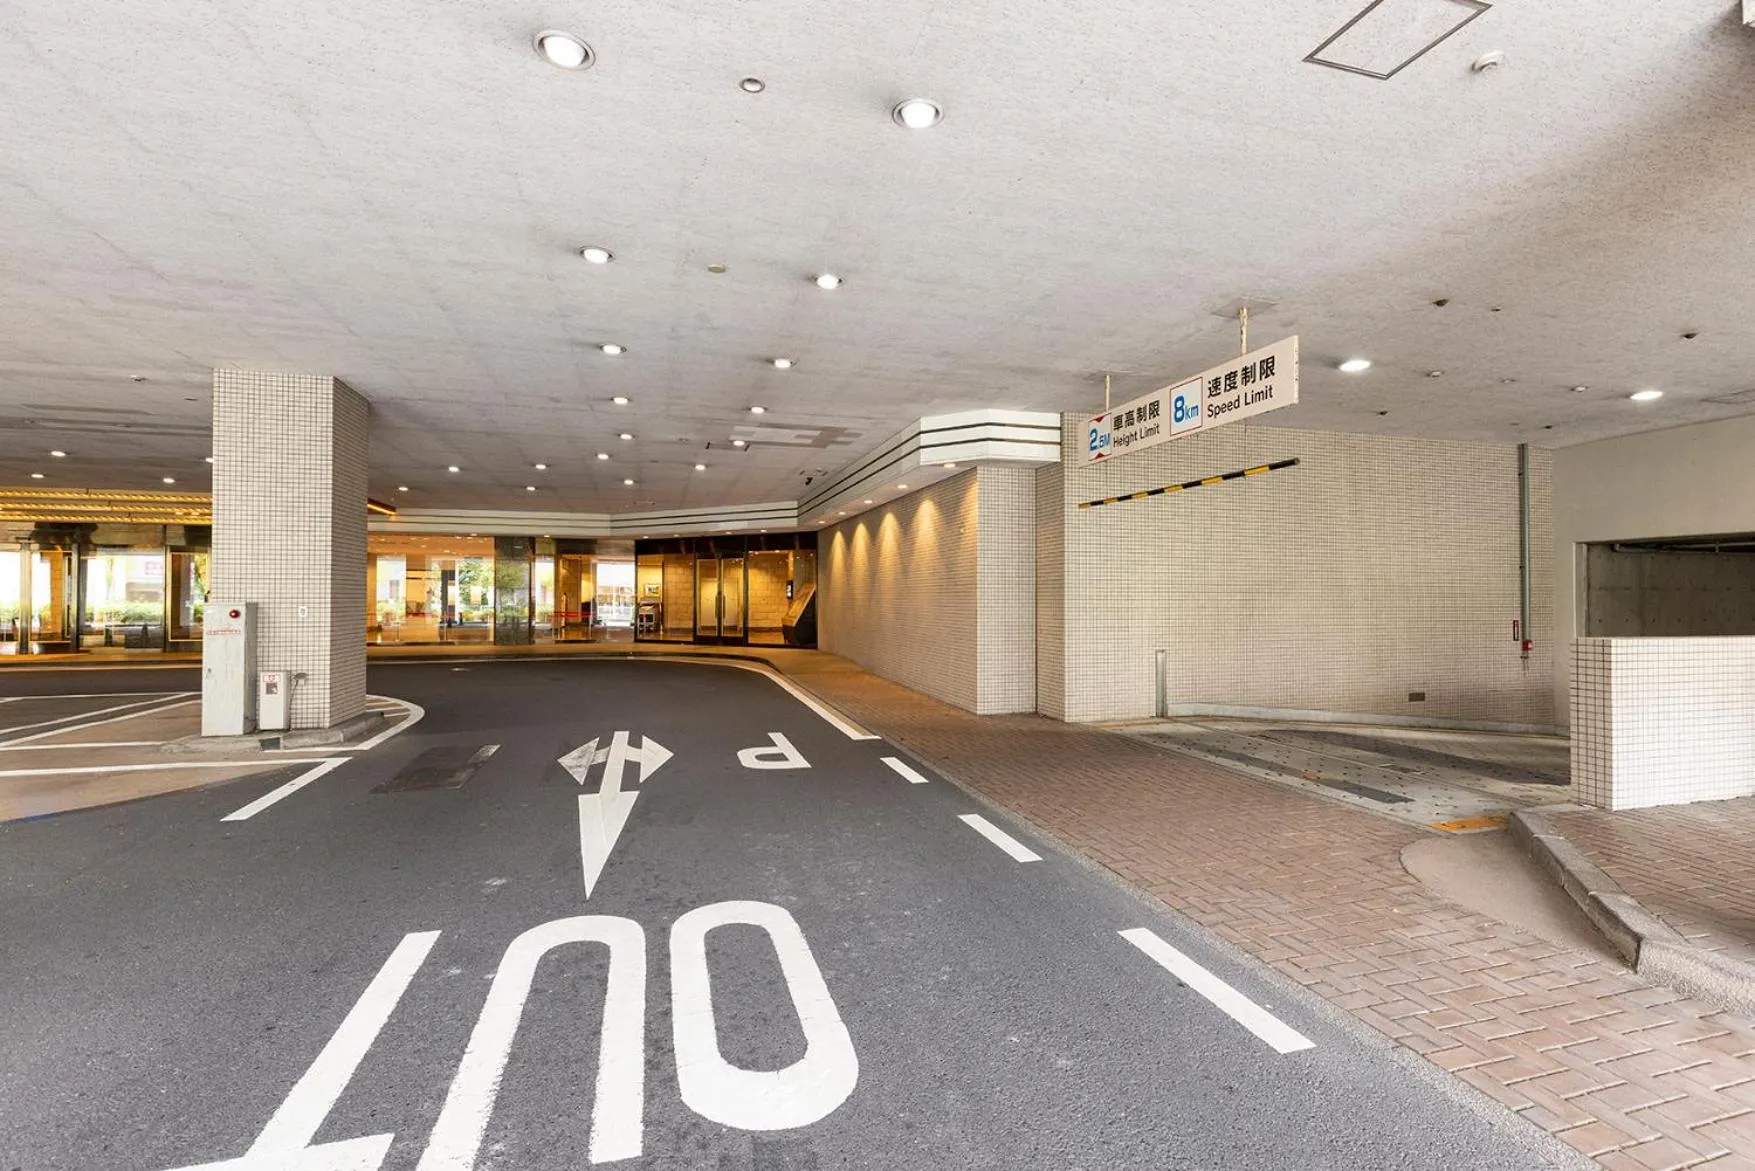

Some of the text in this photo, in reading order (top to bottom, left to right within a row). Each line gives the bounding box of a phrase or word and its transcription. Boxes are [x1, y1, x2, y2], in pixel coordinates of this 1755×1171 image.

[1207, 355, 1276, 399] 速度制限
[1113, 399, 1161, 430] 車高制限
[1173, 395, 1199, 423] 8km
[1207, 385, 1274, 418] Speed Limit
[1113, 423, 1160, 448] Height Limit
[161, 900, 859, 1171] OUT
